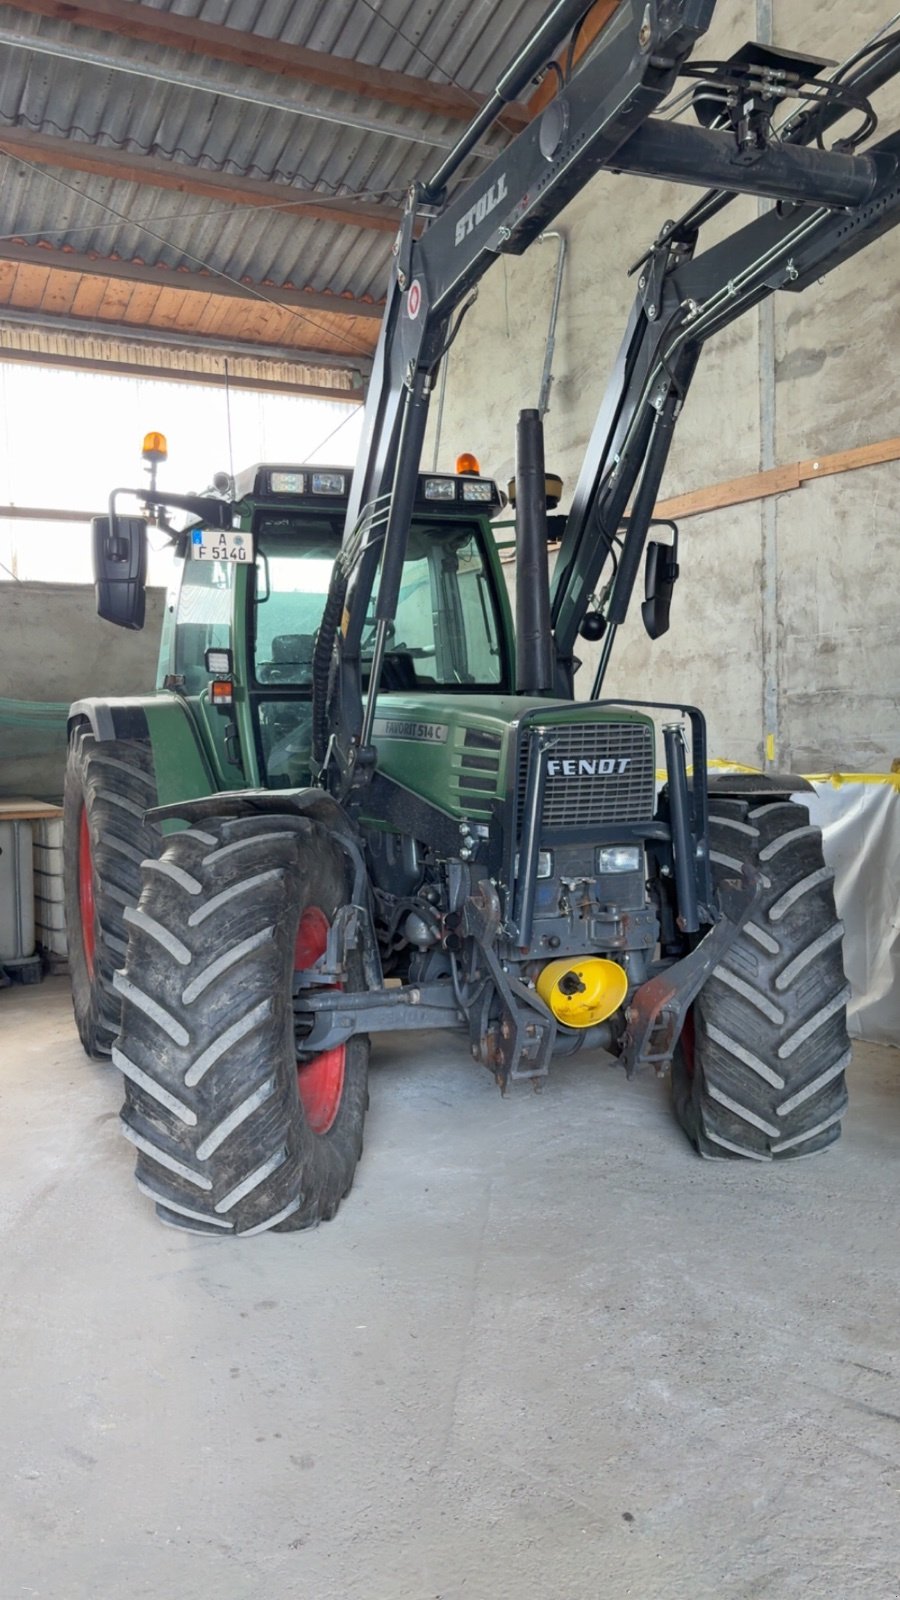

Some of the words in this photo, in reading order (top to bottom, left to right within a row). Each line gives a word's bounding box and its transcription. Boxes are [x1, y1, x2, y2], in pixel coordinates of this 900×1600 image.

[455, 172, 508, 247] STOLL
[219, 533, 226, 546] A
[199, 546, 206, 558] F
[211, 546, 246, 560] 5140
[385, 721, 416, 736] FAVORIT
[417, 724, 433, 738] 514
[434, 726, 442, 739] C
[547, 758, 631, 776] FENDT
